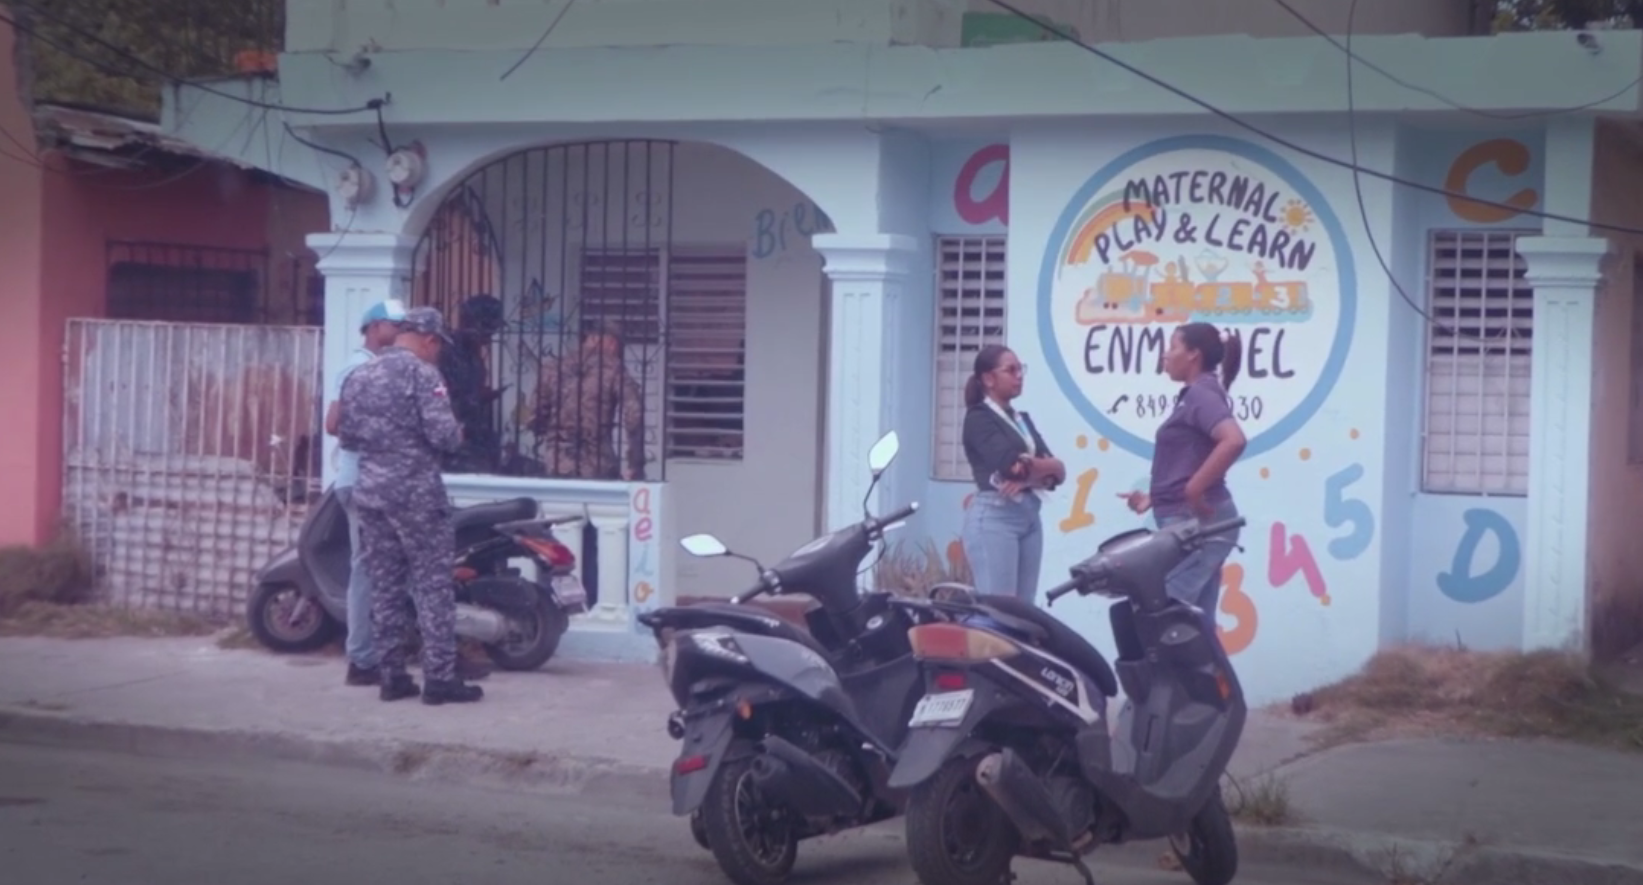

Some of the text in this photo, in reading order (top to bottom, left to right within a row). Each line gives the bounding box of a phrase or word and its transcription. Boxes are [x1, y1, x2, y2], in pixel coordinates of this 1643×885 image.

[1122, 170, 1280, 223] MATERNAL
[1445, 138, 1539, 223] C
[1094, 208, 1316, 271] PLAY & LEARN
[1084, 324, 1295, 378] ENMEL
[634, 516, 653, 541] e
[1059, 467, 1098, 533] 1
[1323, 462, 1375, 561] 5
[1268, 521, 1327, 597] 4
[1436, 507, 1521, 604] D
[1216, 562, 1259, 656] 3
